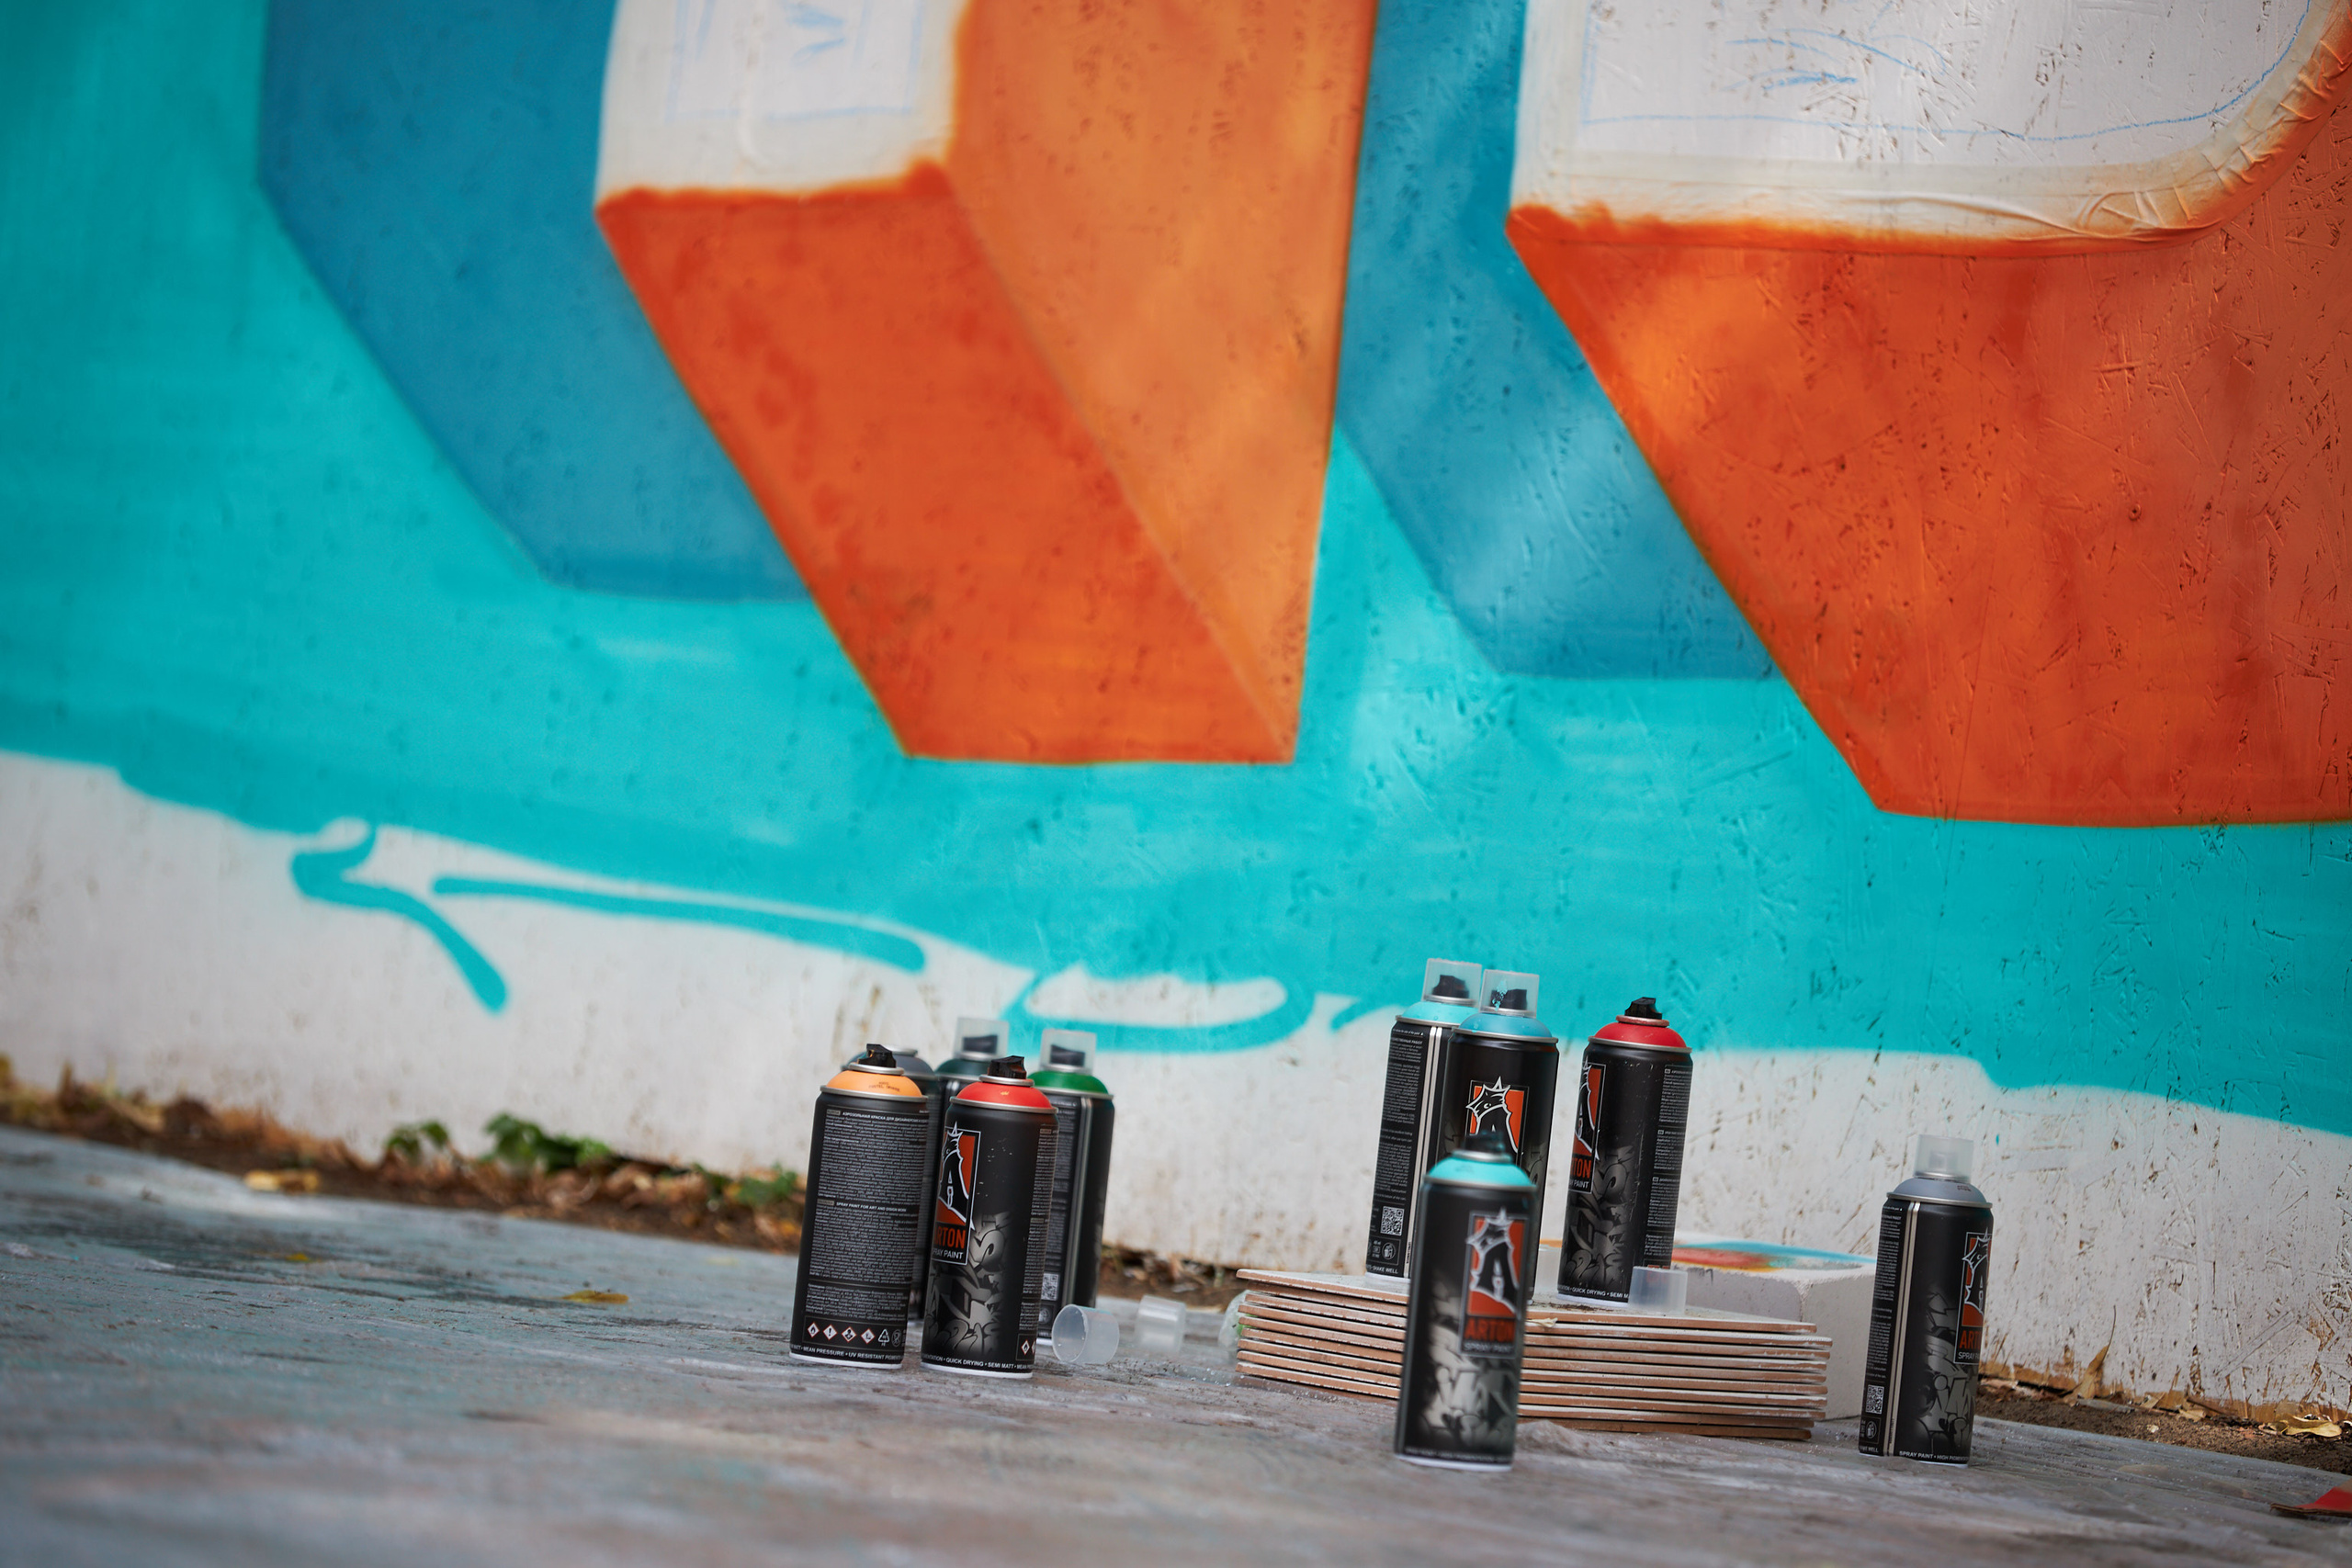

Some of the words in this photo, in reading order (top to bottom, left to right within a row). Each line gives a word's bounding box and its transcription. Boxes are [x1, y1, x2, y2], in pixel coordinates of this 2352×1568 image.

[1574, 1179, 1589, 1189] PAINT
[943, 1249, 964, 1259] PAINT
[1572, 1286, 1586, 1294] QUICK
[803, 1345, 816, 1353] MEAN
[816, 1348, 844, 1357] PRESSURE
[945, 1357, 962, 1365] QUICK
